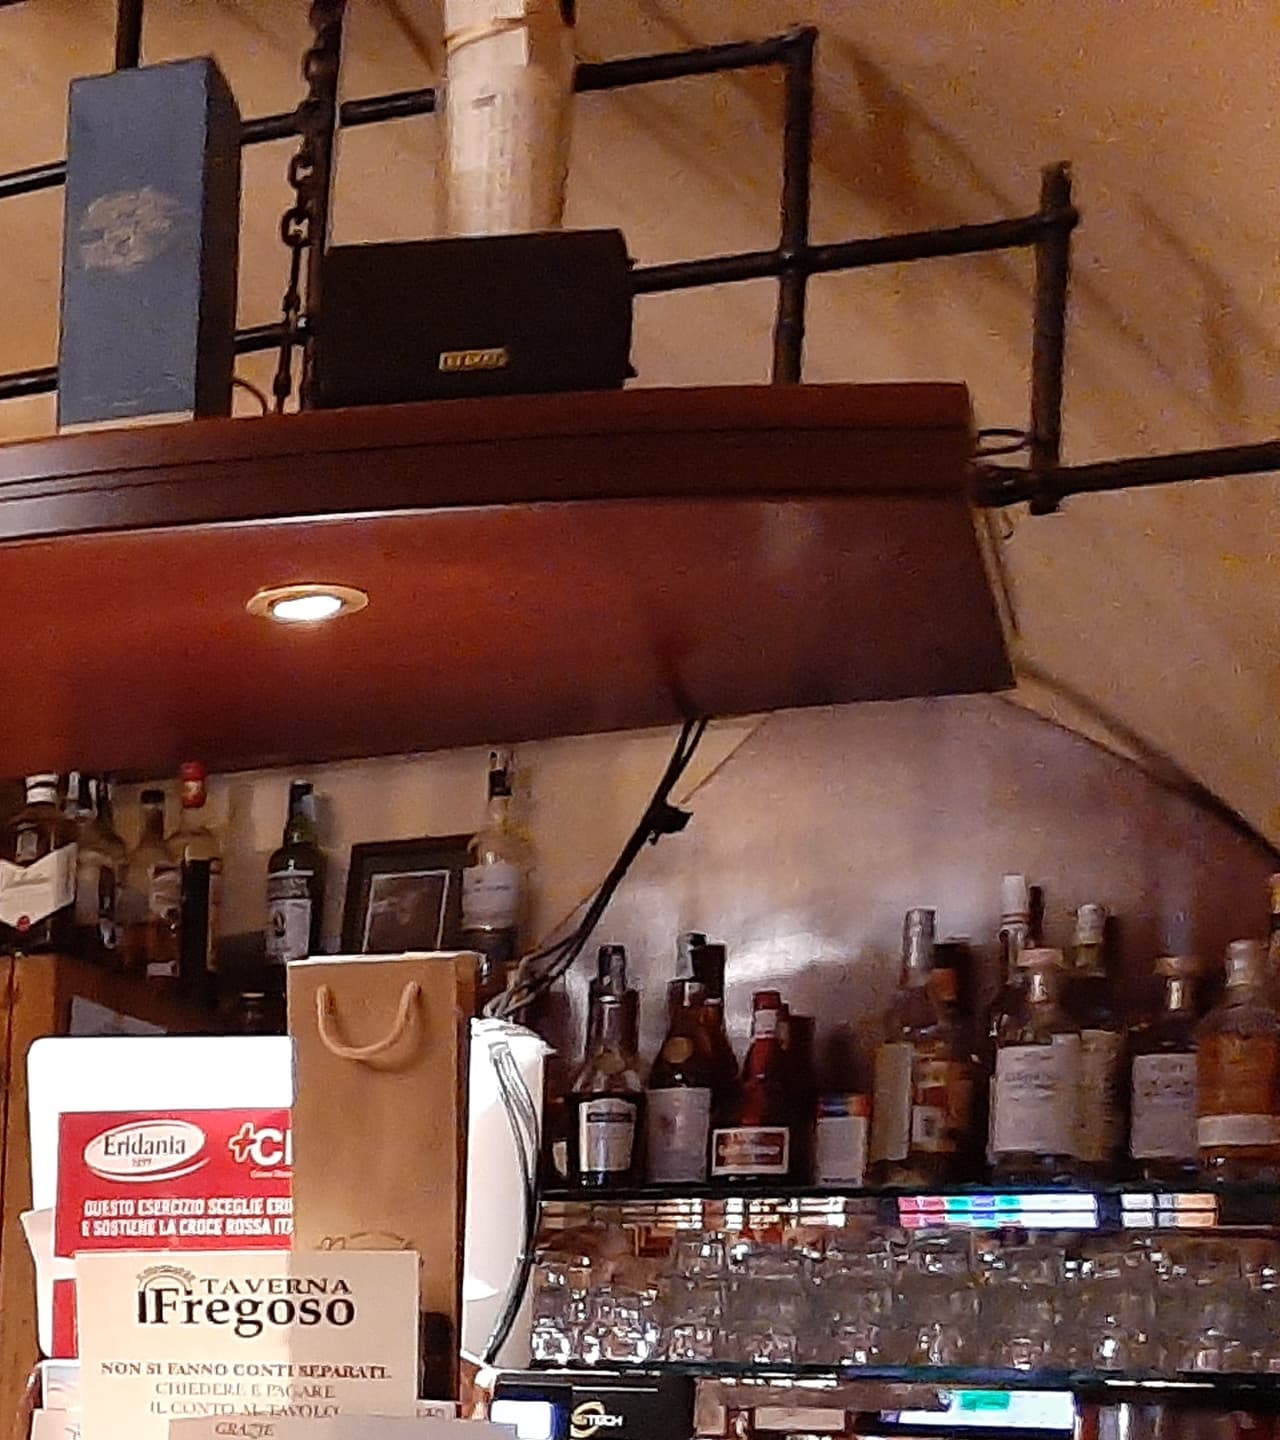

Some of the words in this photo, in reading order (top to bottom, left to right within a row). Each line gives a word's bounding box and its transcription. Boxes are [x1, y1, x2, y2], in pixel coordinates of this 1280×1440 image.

[103, 1132, 186, 1157] Eridania
[252, 1128, 291, 1167] C
[84, 1199, 135, 1217] QUESTO
[138, 1198, 205, 1216] ESERCIZIO
[207, 1197, 264, 1215] SCEGLIE
[93, 1219, 156, 1237] SOSTIENE
[159, 1218, 177, 1236] LA
[179, 1218, 222, 1235] CROCE
[225, 1217, 273, 1235] ROSSA
[199, 1278, 352, 1295] TAVERNA
[101, 1362, 141, 1376] NON
[146, 1362, 161, 1376] SI
[168, 1362, 227, 1377] FANNO
[233, 1363, 294, 1378] CONTI
[150, 1401, 167, 1414] IL
[171, 1400, 235, 1416] CONTO
[266, 1403, 340, 1418] TAVOLO
[214, 1422, 274, 1440] GRAZIE
